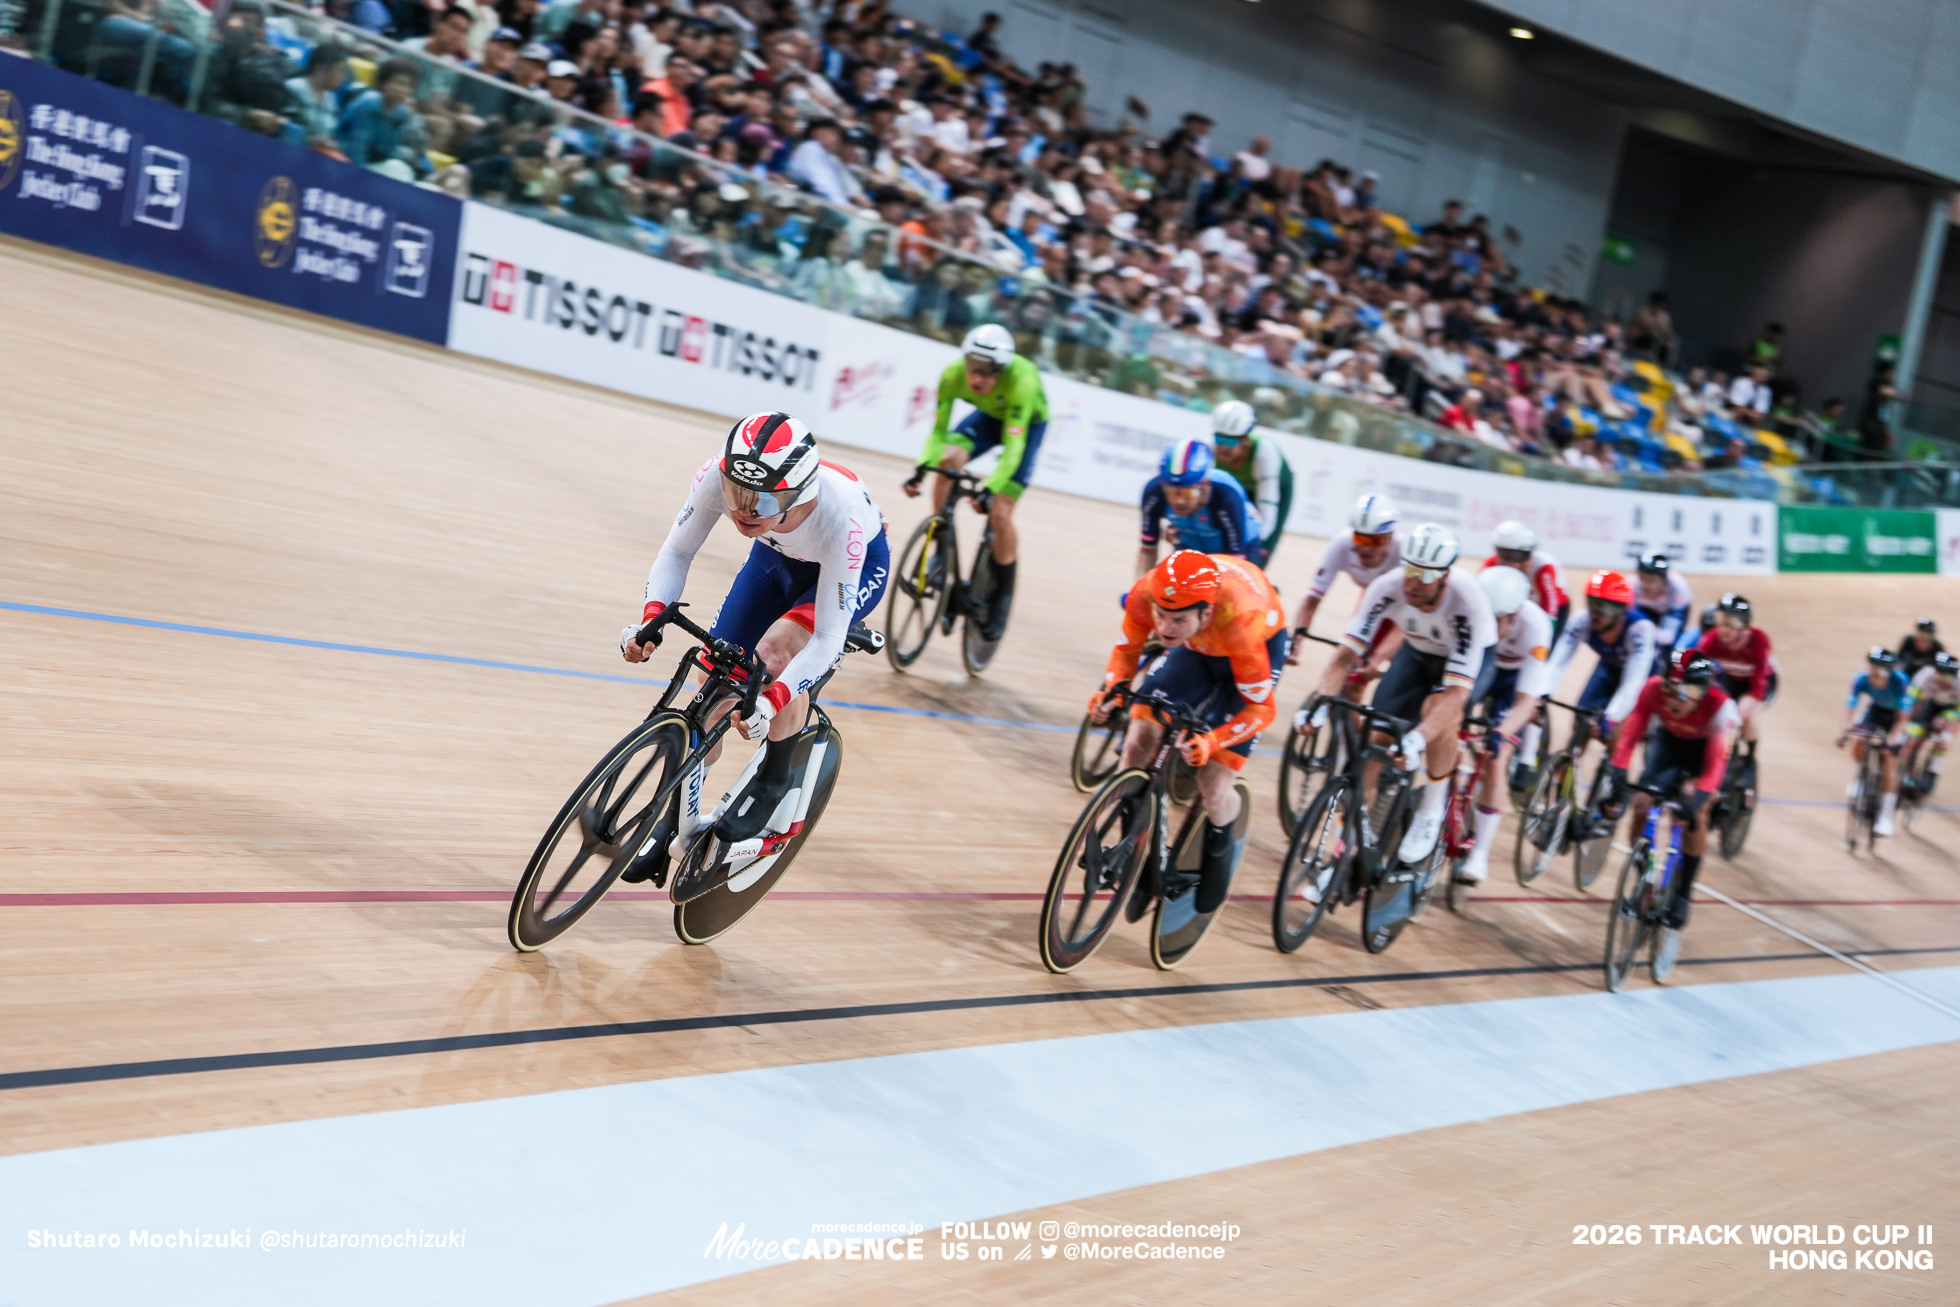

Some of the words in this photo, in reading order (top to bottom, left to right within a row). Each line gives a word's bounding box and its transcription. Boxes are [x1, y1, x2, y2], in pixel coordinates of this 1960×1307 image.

[523, 268, 654, 350] TISSOT
[710, 321, 820, 393] TISSOT
[730, 470, 764, 488] Kabuto
[837, 581, 845, 611] KEIRIN
[686, 762, 702, 818] TORAY
[729, 848, 759, 859] JAPAN
